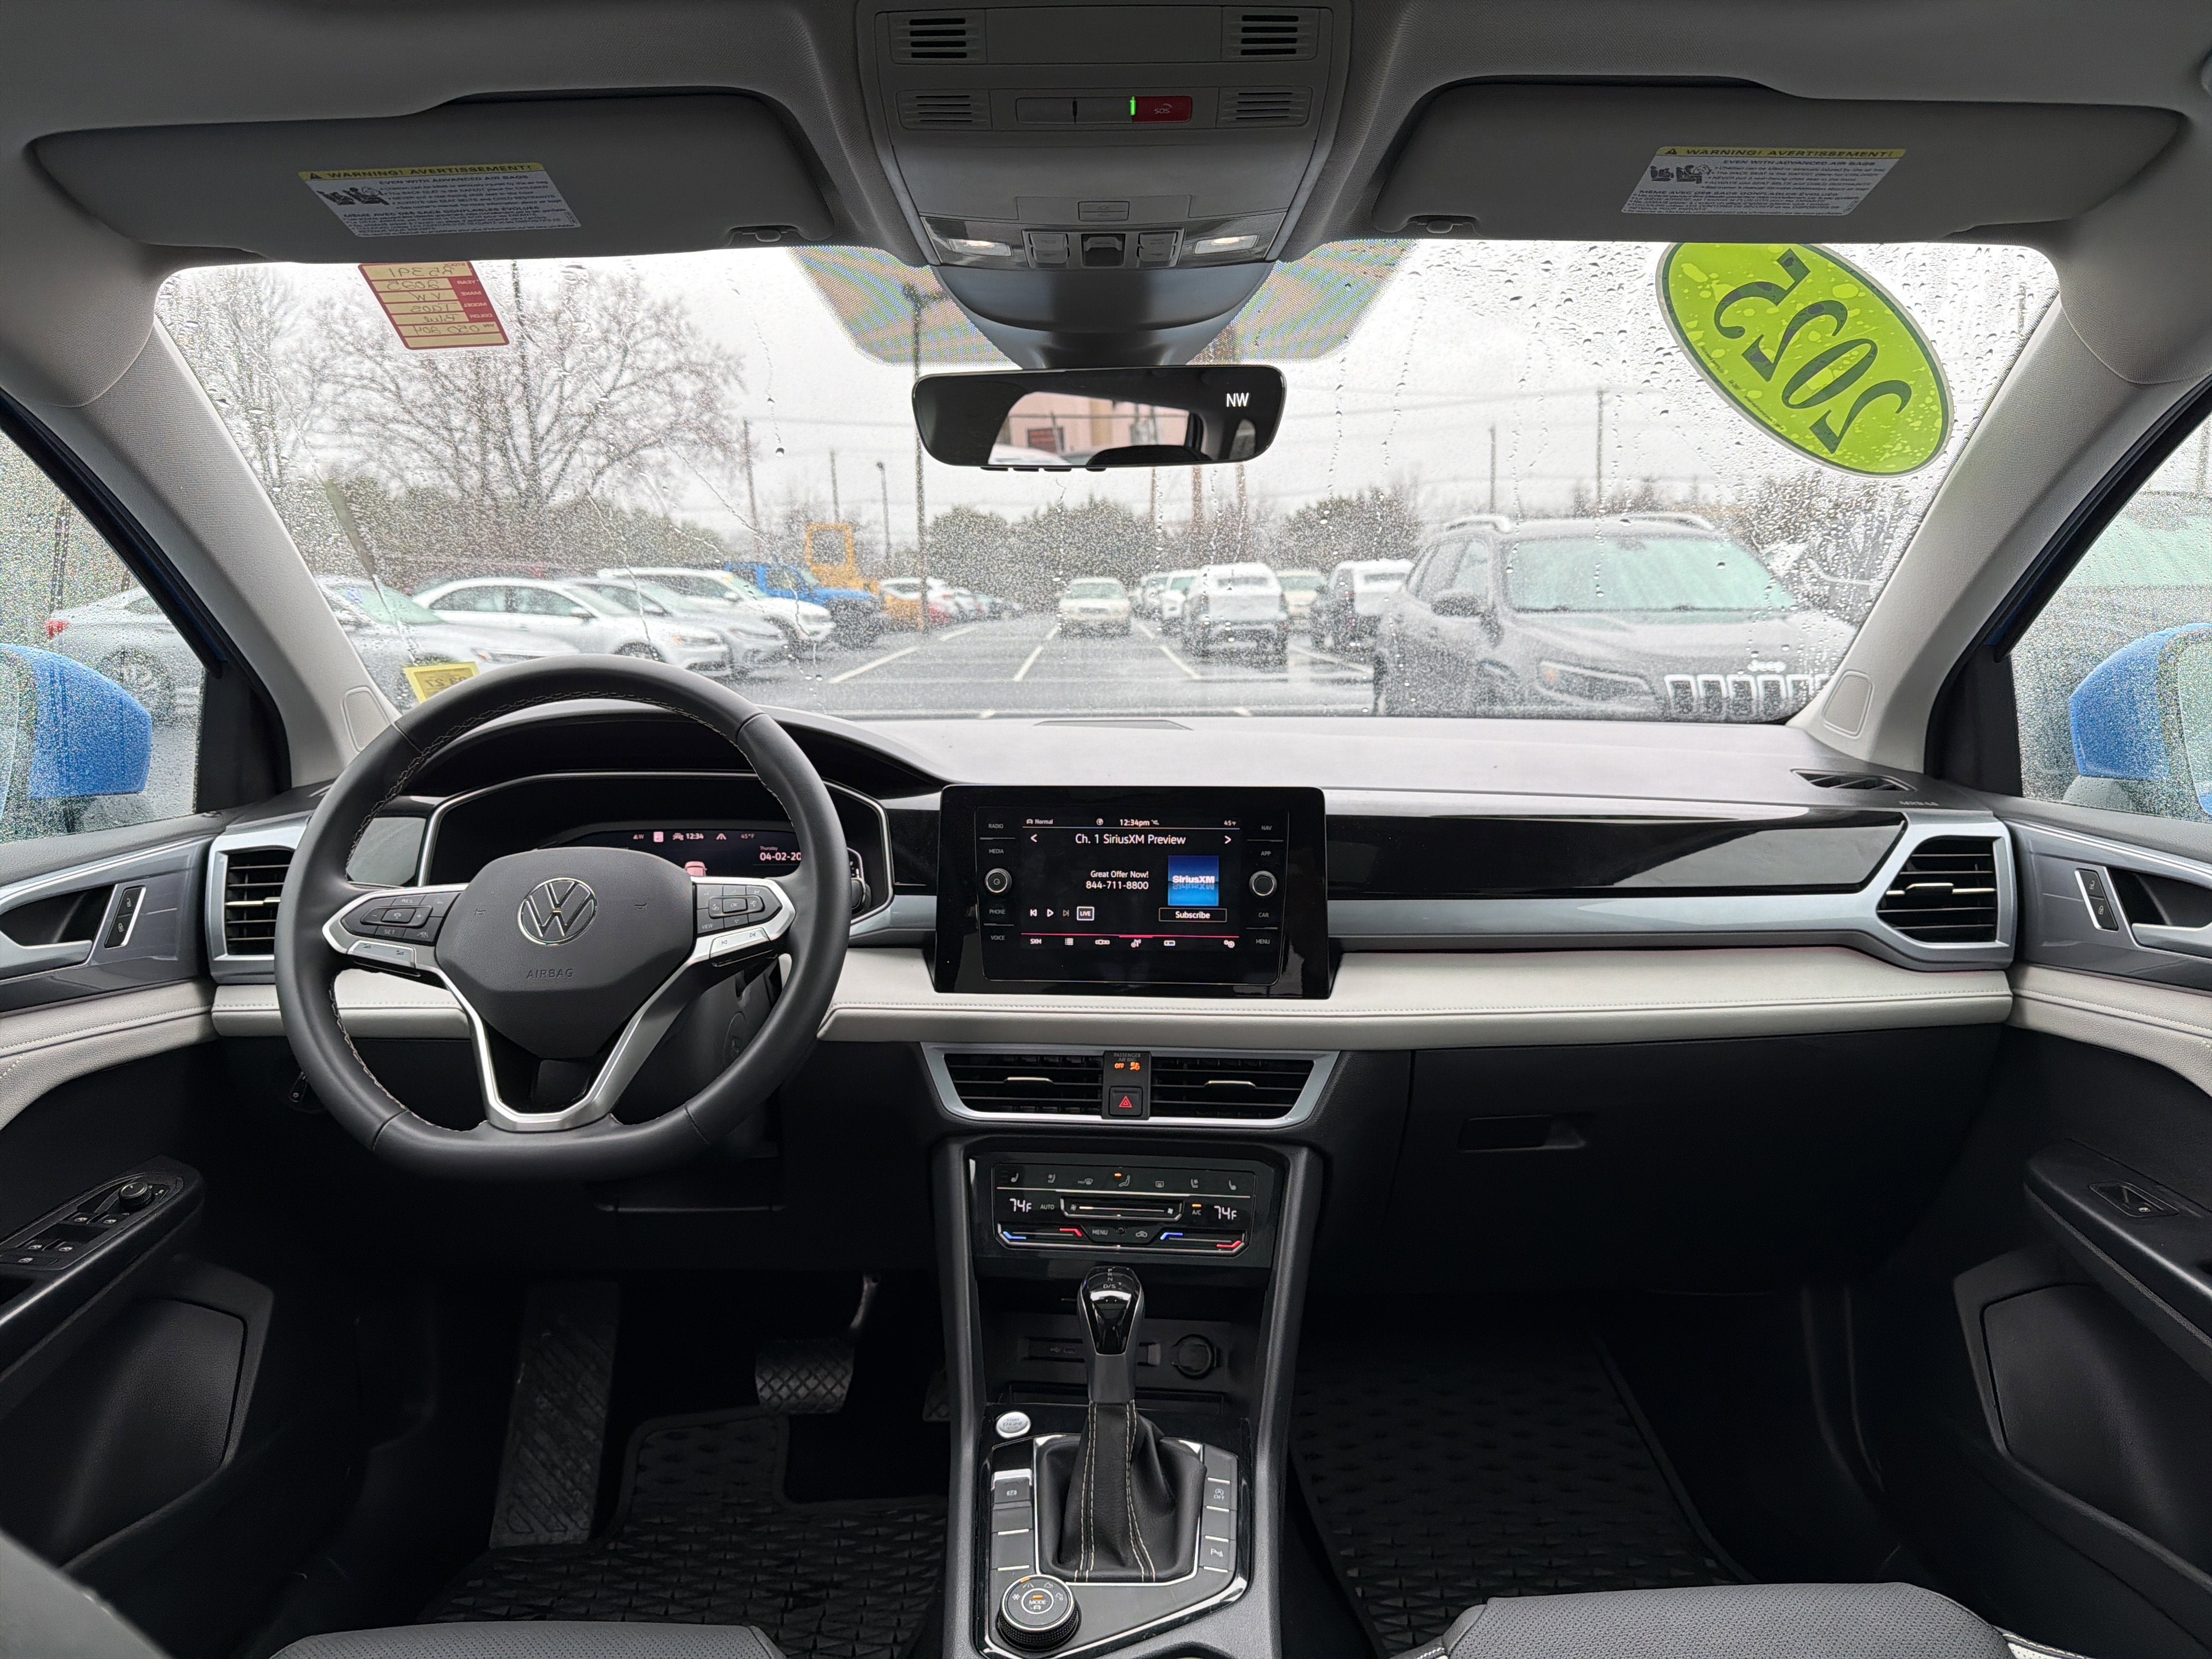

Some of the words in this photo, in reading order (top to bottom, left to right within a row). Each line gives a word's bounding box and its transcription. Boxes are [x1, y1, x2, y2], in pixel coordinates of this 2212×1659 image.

[328, 170, 403, 178] WARNING!
[410, 165, 531, 174] AVERTISSEMENT!
[1226, 392, 1250, 408] NW
[1747, 659, 1787, 673] Jeep
[1119, 819, 1150, 827] 12:34pm
[1075, 833, 1091, 844] Ch.
[1094, 833, 1099, 844] 1
[1103, 833, 1144, 845] SiriusXM
[1148, 834, 1186, 845] Preview
[1090, 870, 1109, 878] Great
[1110, 870, 1128, 878] Offer
[1130, 870, 1149, 878] Now!
[1172, 875, 1215, 884] SiriusXM
[1086, 881, 1149, 890] 844-711-8800
[1175, 911, 1211, 919] Subscribe
[526, 968, 574, 979] AIRBAG
